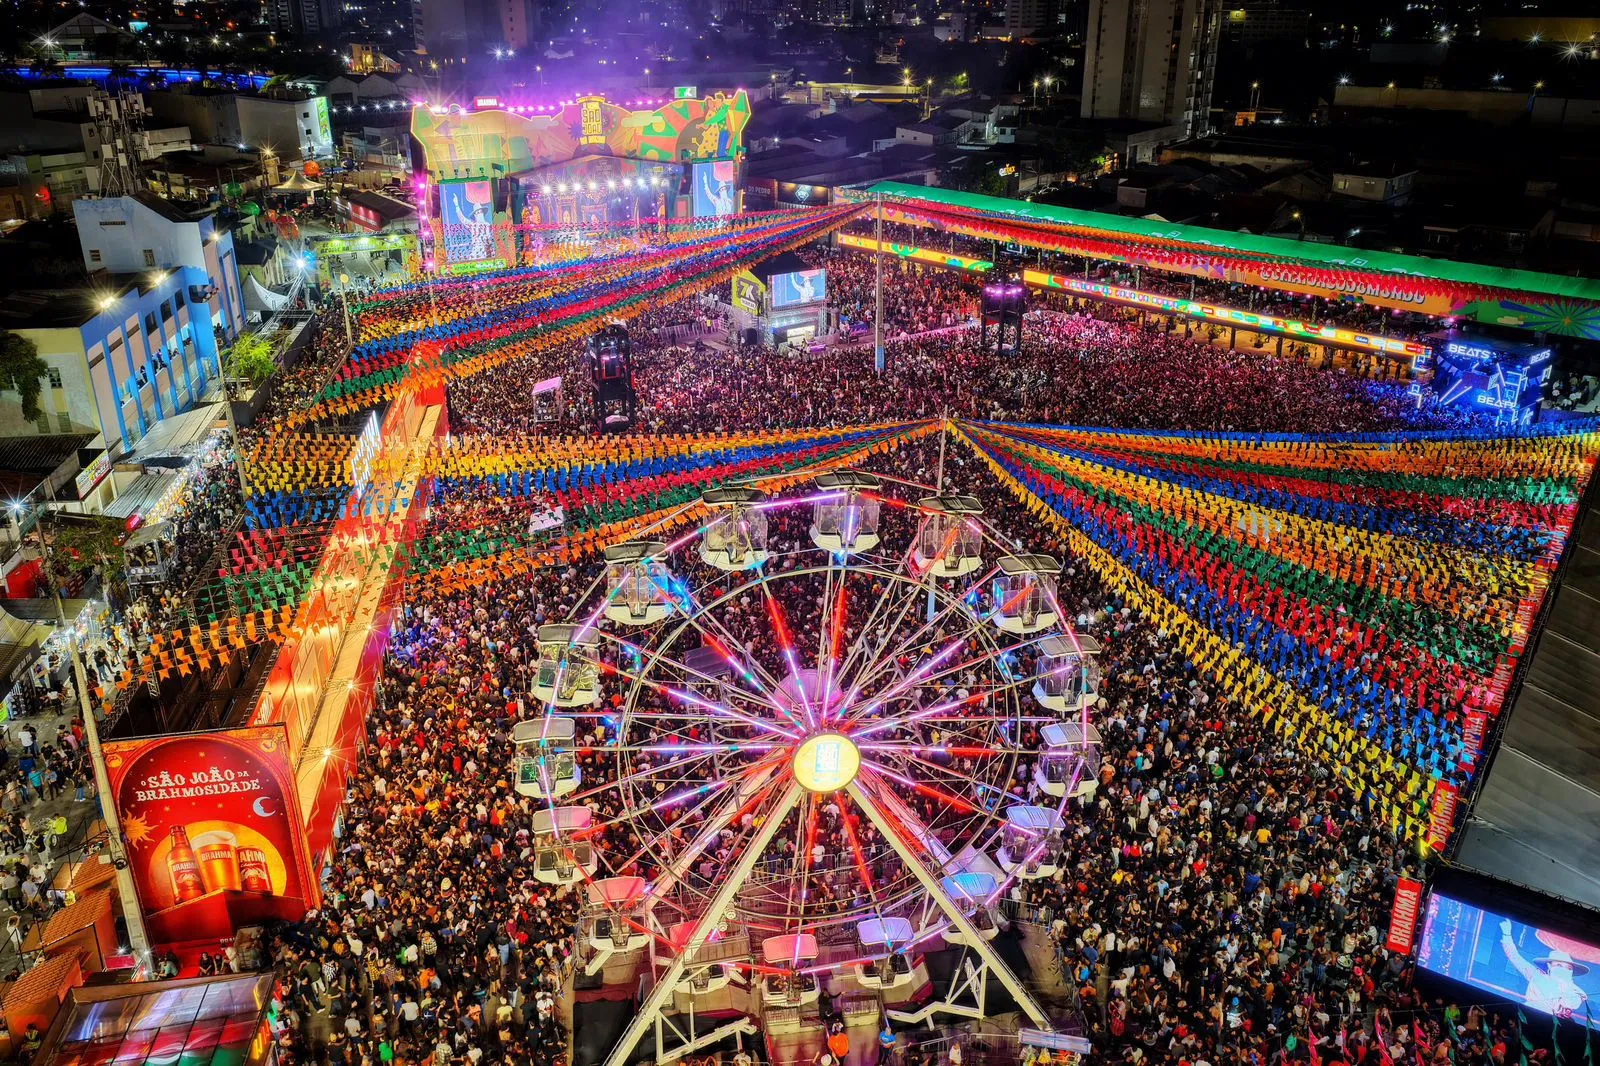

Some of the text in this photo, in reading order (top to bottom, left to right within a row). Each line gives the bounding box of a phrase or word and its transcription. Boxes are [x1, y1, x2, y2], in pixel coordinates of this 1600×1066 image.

[1448, 343, 1491, 358] BEATS
[1530, 349, 1551, 365] BEATS
[147, 771, 186, 788] SÃO
[189, 766, 235, 784] JOÃO
[237, 770, 250, 778] DA
[201, 850, 233, 862] BRAHMA
[1389, 888, 1418, 947] BRAHMA
